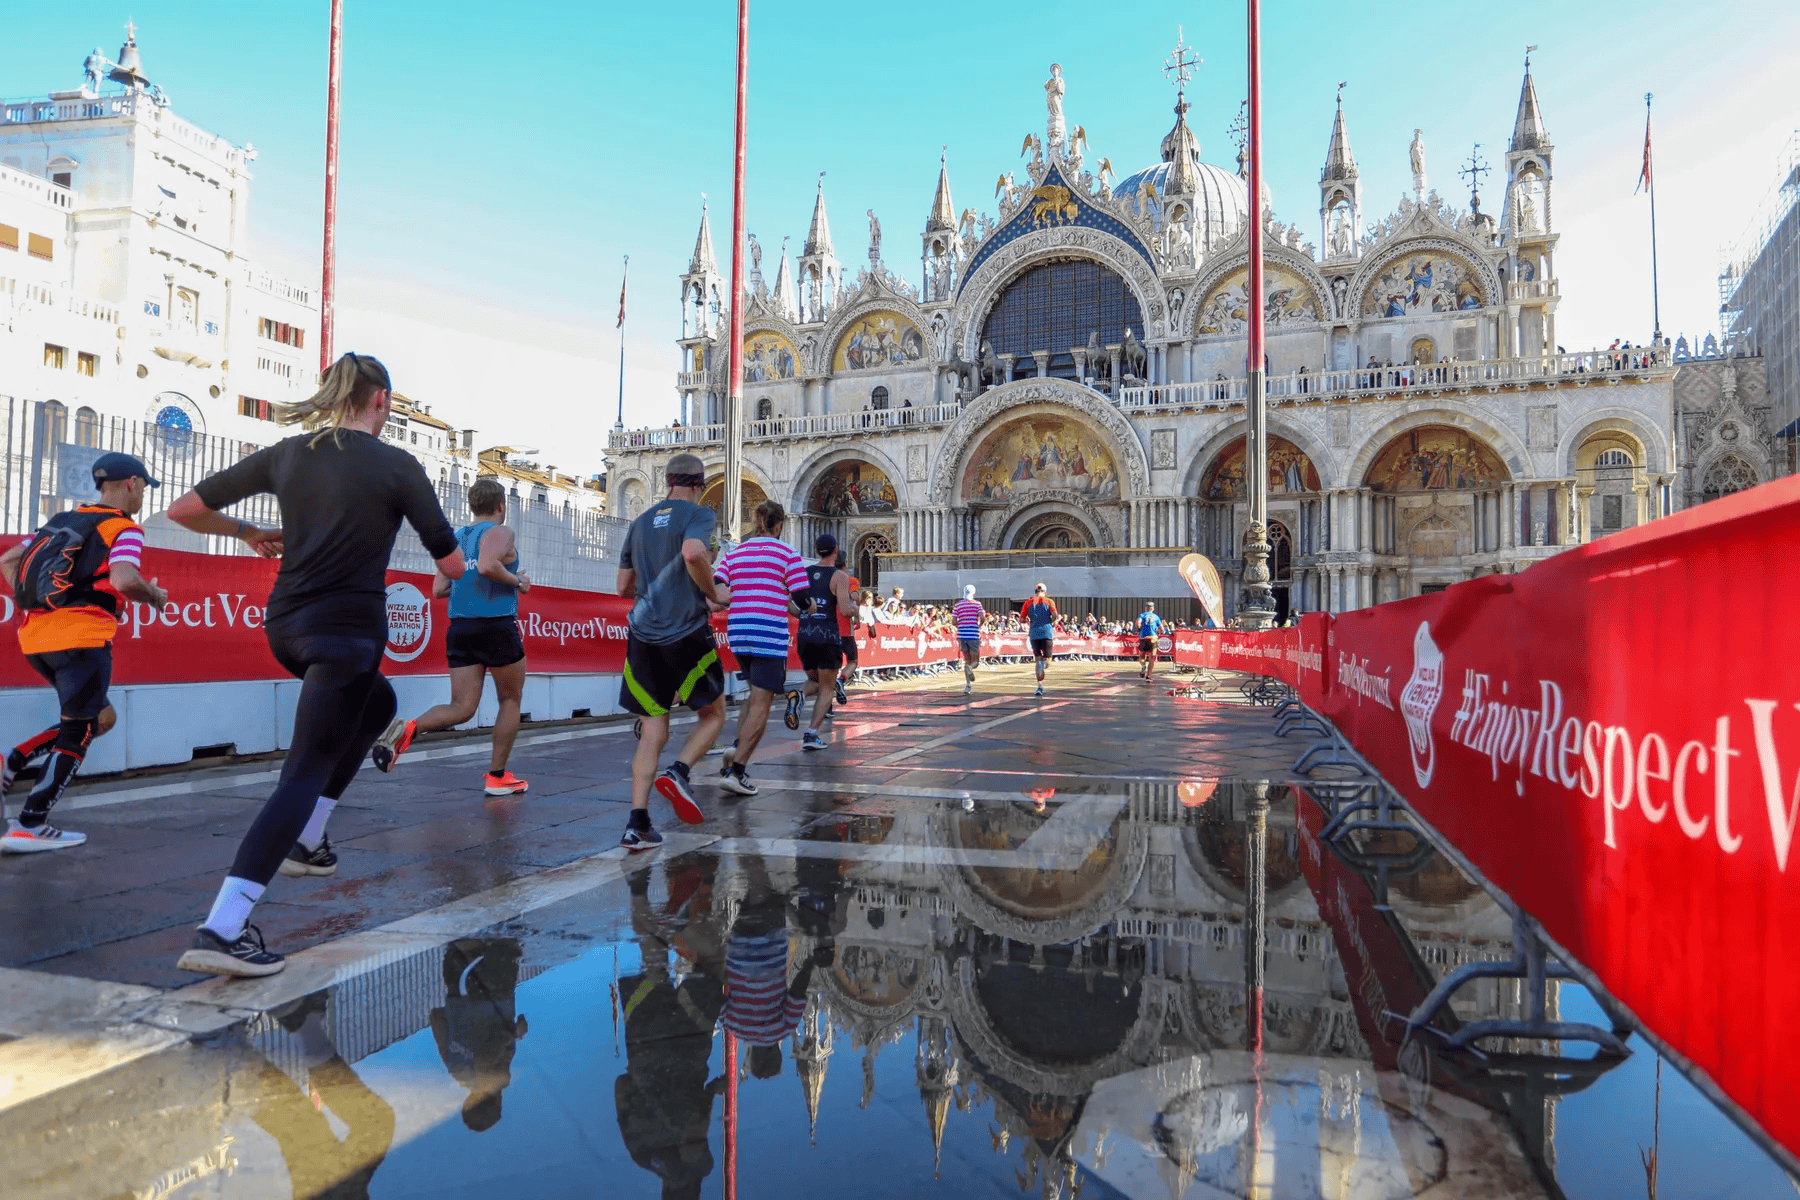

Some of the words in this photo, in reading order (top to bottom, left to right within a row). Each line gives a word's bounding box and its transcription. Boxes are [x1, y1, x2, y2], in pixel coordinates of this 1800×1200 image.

[386, 611, 420, 622] VENICE
[389, 622, 420, 630] ARATHON
[514, 612, 629, 645] yRespectVene
